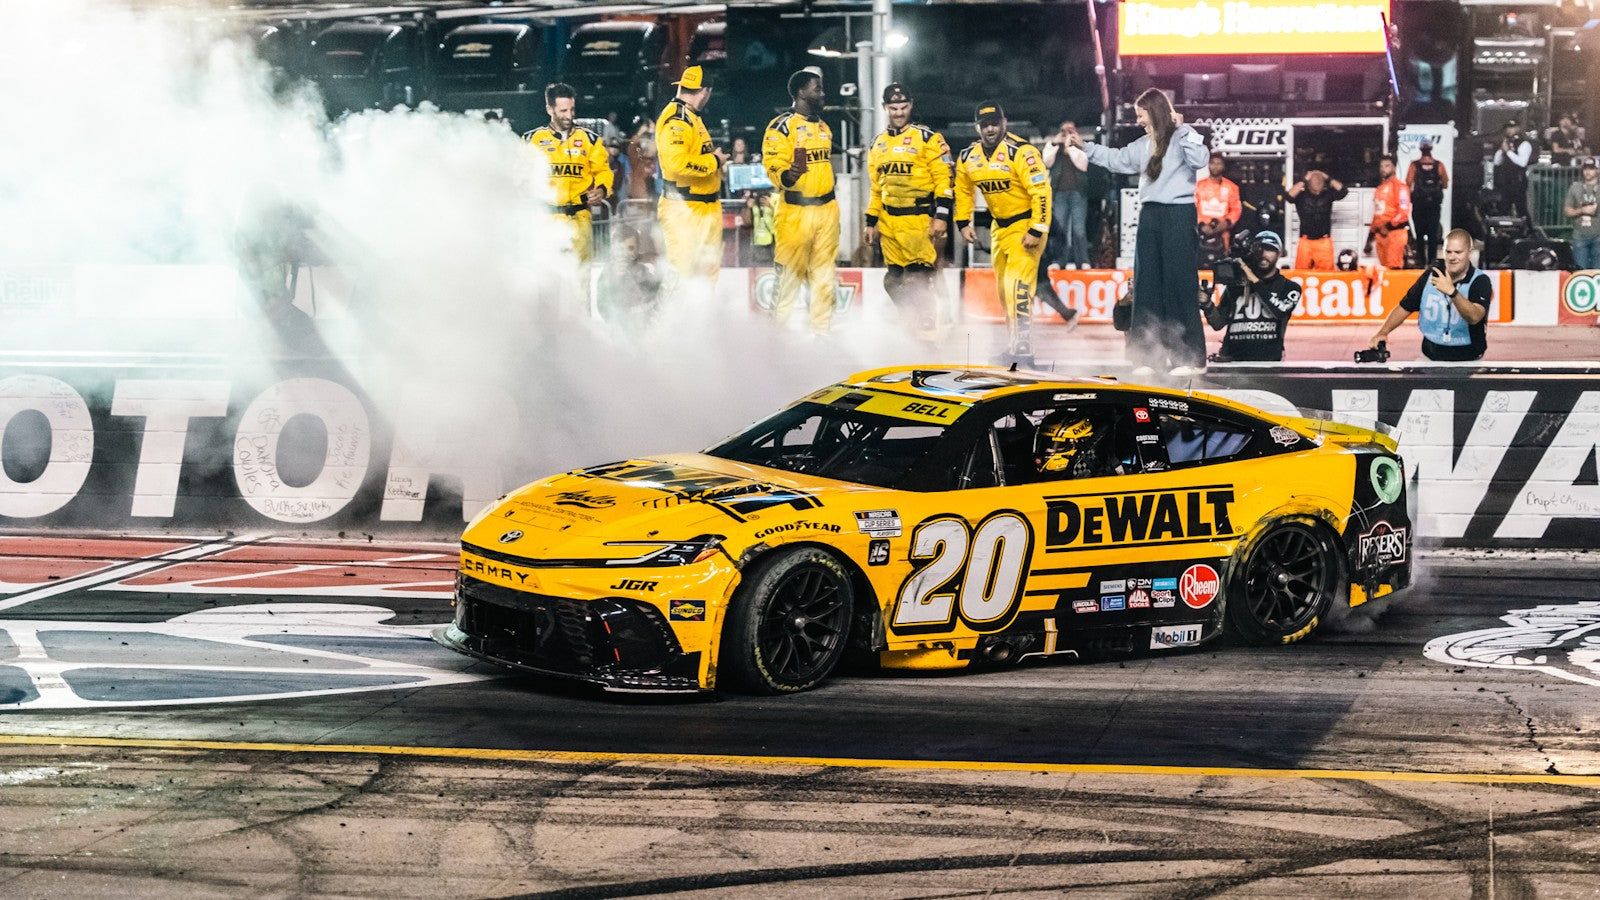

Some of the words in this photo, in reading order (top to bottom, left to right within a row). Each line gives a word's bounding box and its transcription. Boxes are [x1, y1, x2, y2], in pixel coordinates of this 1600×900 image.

[1225, 130, 1287, 145] JGR
[1236, 321, 1278, 332] NASCAR
[902, 402, 952, 418] BELL
[754, 520, 842, 539] GOODYEAR
[864, 520, 876, 528] CUP
[465, 558, 529, 584] CAMRY
[891, 510, 1033, 631] 20
[609, 579, 659, 592] JGR
[1184, 565, 1217, 602] Rheem
[1129, 590, 1149, 603] MAC
[1152, 590, 1171, 598] Sport
[1154, 631, 1185, 644] Mobil
